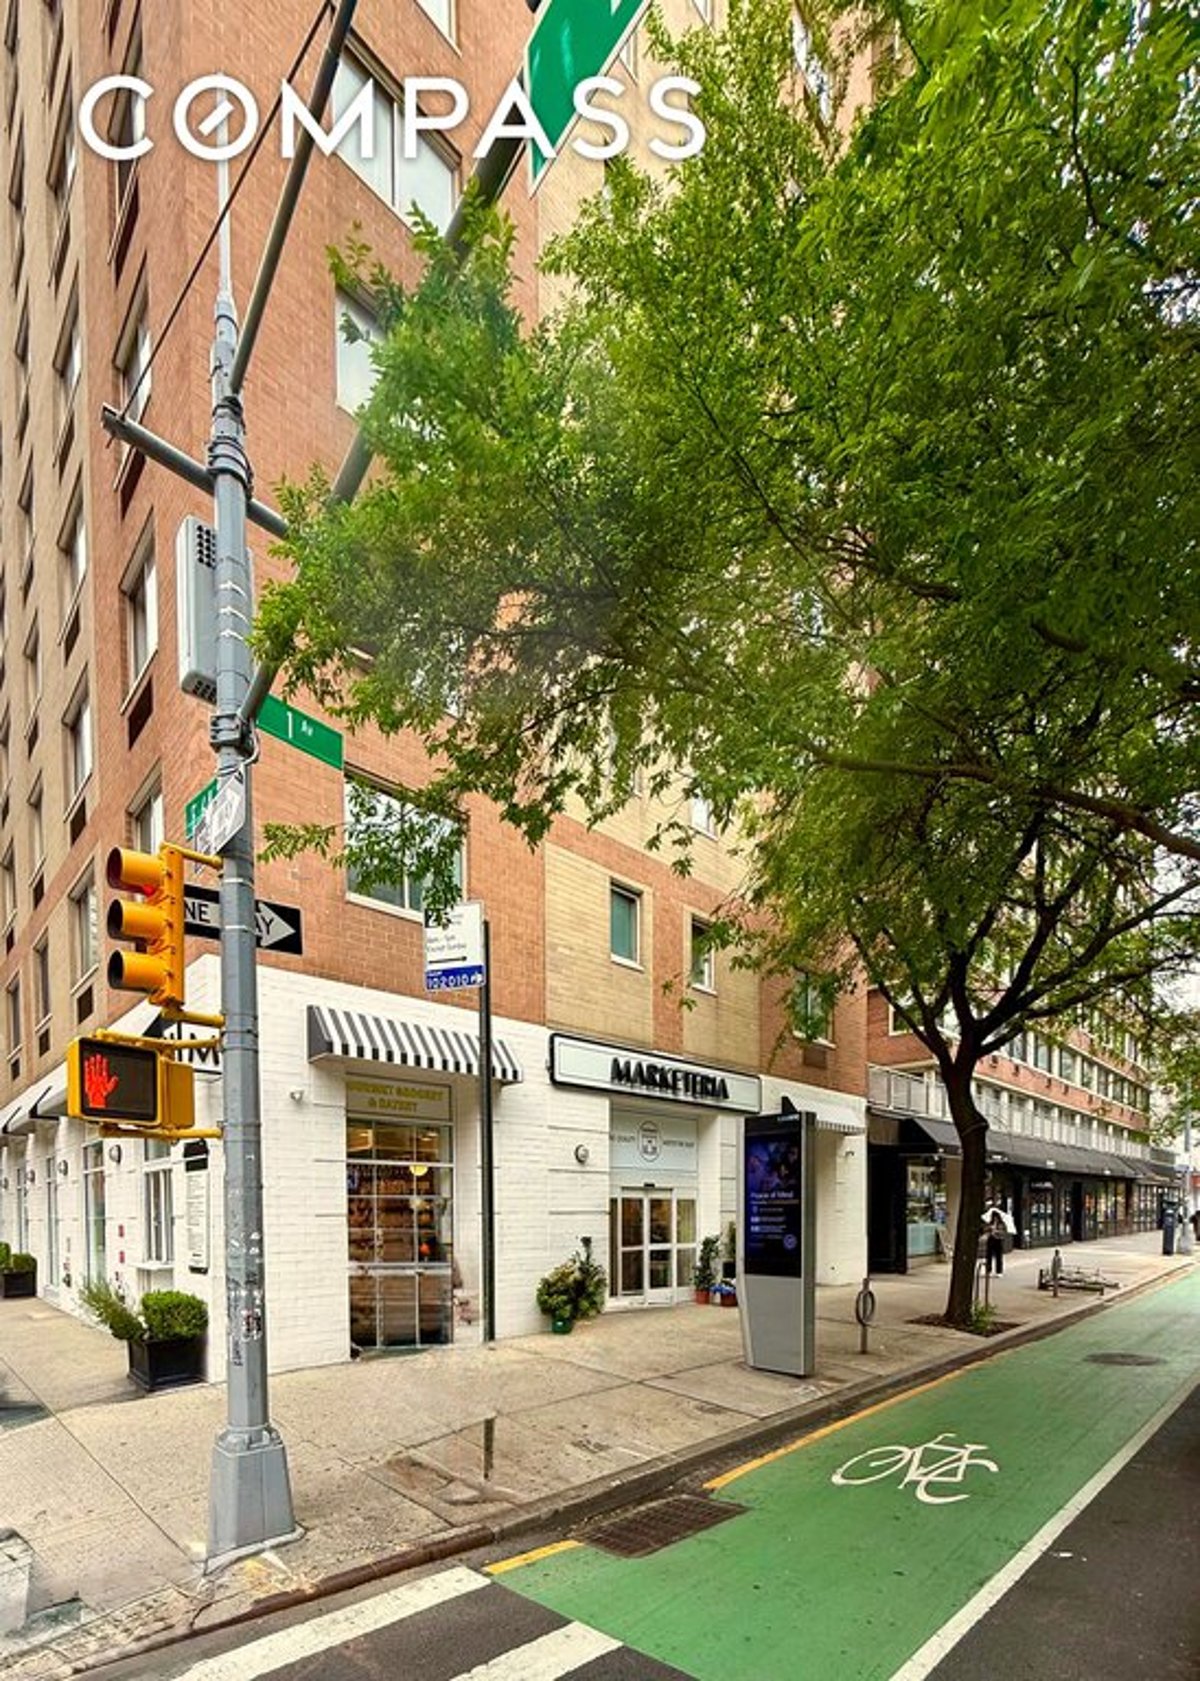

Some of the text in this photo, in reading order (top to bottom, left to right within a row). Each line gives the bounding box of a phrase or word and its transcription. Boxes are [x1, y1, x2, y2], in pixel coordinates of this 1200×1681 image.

[286, 711, 293, 739] 1
[184, 900, 211, 924] NE
[610, 1057, 730, 1099] MARKETERIA
